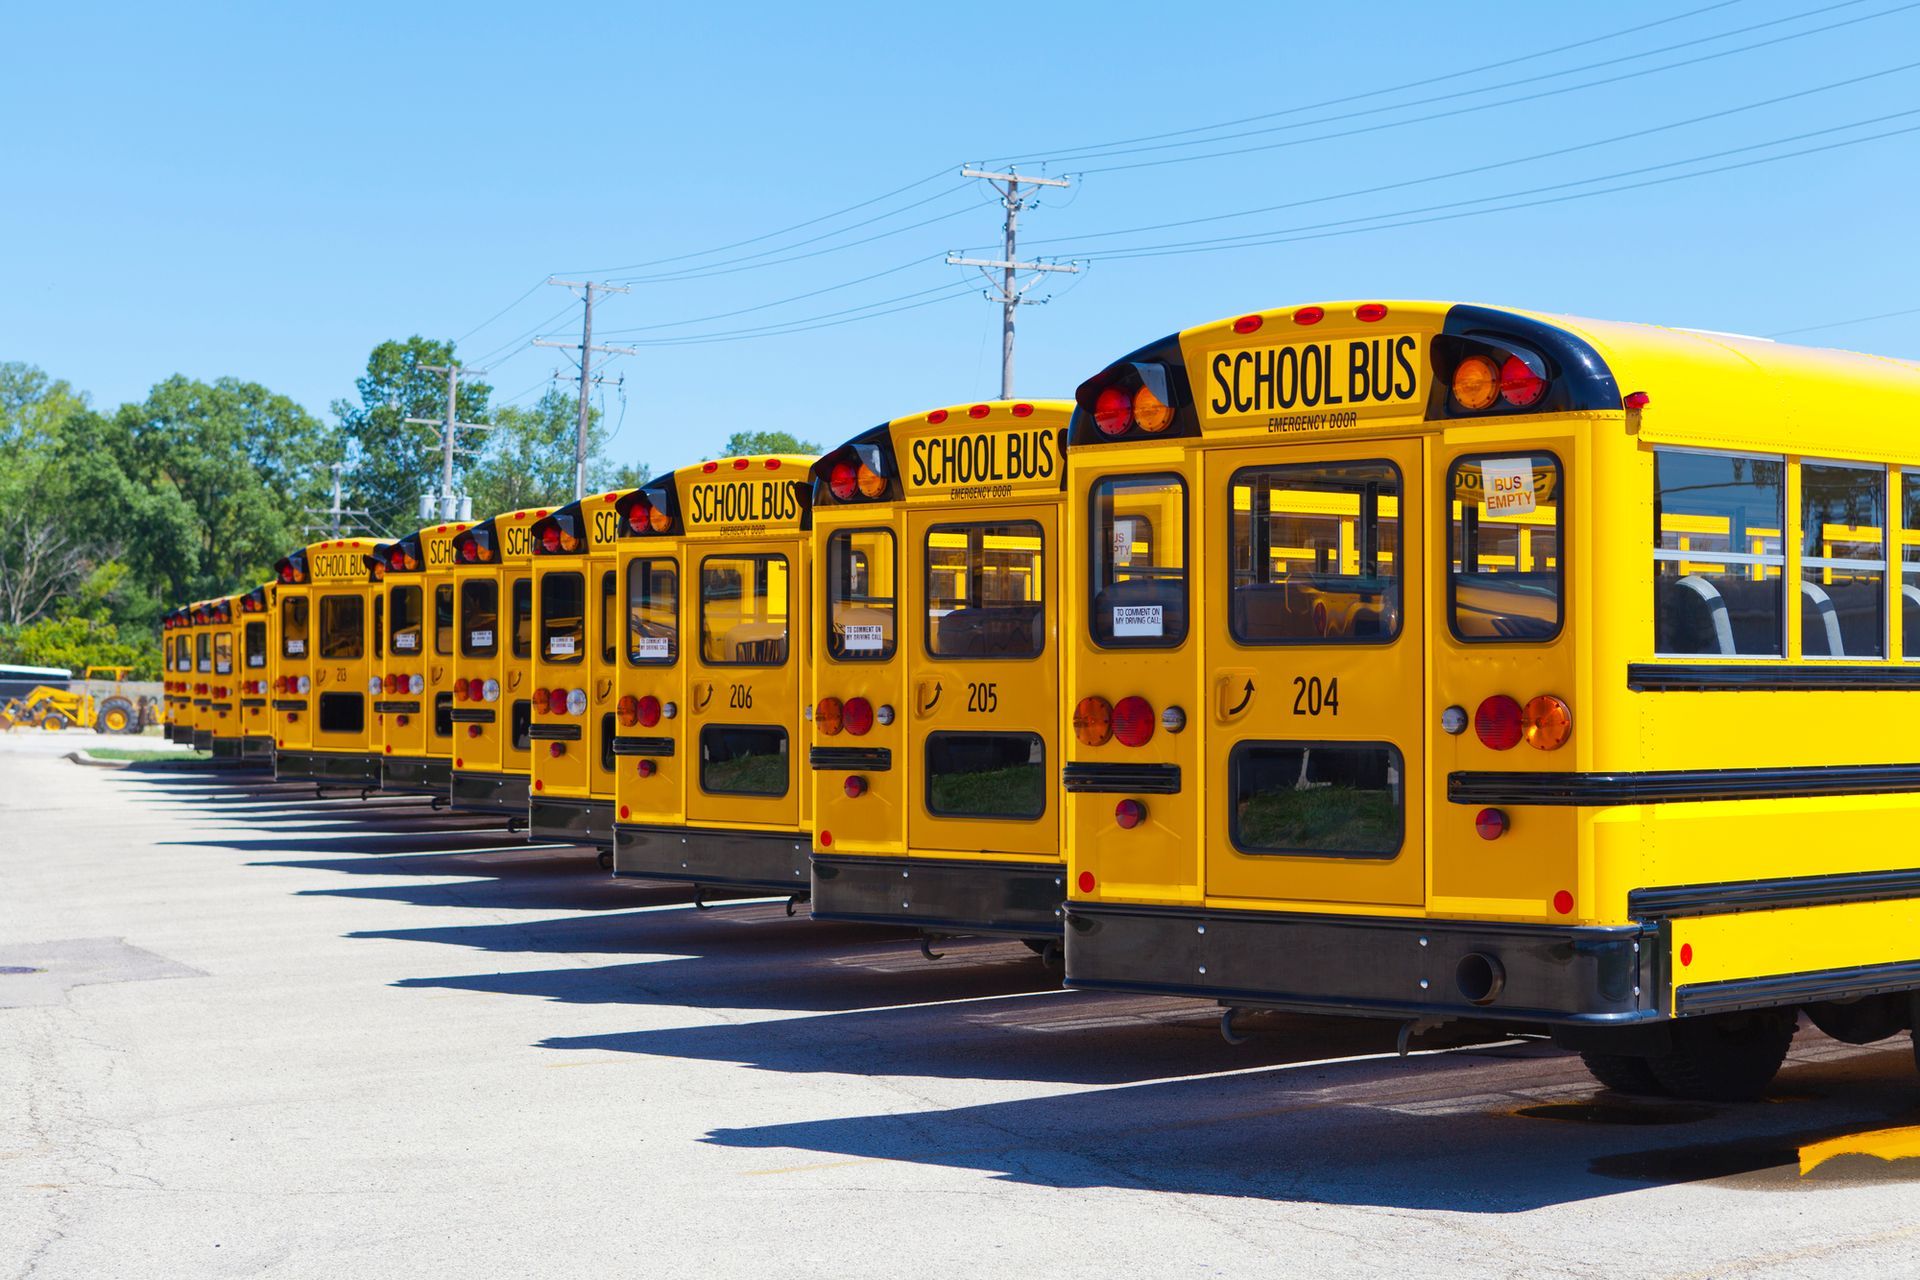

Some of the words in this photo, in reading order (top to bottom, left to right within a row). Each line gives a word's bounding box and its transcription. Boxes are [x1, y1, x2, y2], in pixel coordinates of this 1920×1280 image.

[1212, 344, 1342, 414] SCHOOL
[1349, 336, 1416, 403] BUS
[1268, 414, 1327, 432] EMERGENCY
[1329, 412, 1357, 428] DOOR
[913, 434, 1003, 486] SCHOOL
[1007, 429, 1053, 479] BUS
[951, 487, 992, 500] EMERGENCY
[993, 485, 1012, 497] DOOR
[1494, 476, 1522, 491] BUS
[692, 482, 758, 523] SCHOOL
[762, 480, 796, 519] BUS
[1487, 491, 1533, 509] EMPTY
[430, 539, 454, 564] SCH
[507, 527, 534, 555] SCH
[315, 554, 348, 577] SCHOOL
[1117, 608, 1124, 616] TO
[1125, 608, 1151, 616] COMMENT
[1152, 607, 1160, 616] ON
[1125, 616, 1146, 624] DRIVING
[730, 684, 752, 709] 206
[968, 682, 997, 712] 205
[1293, 676, 1338, 716] 204
